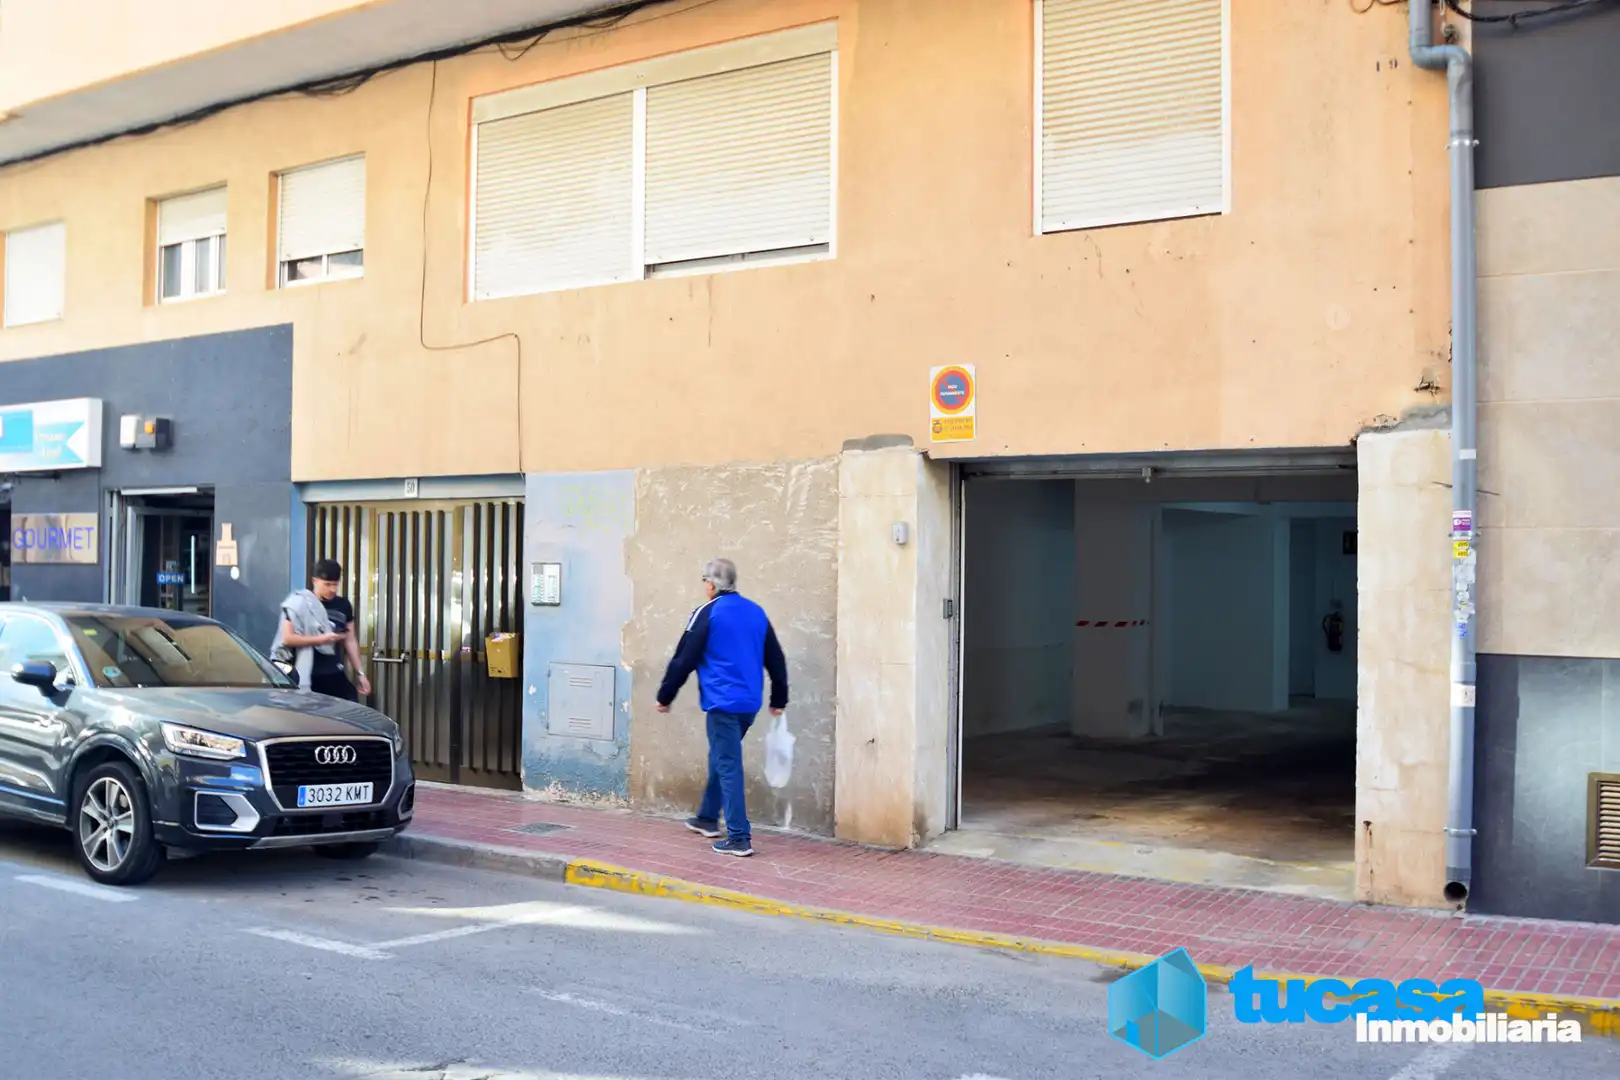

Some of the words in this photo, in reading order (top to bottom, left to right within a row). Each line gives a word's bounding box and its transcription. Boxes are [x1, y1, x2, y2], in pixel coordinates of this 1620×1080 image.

[12, 527, 95, 551] GOURMET
[158, 574, 184, 583] OPEN
[308, 787, 343, 803] 3032
[345, 785, 370, 801] KMT
